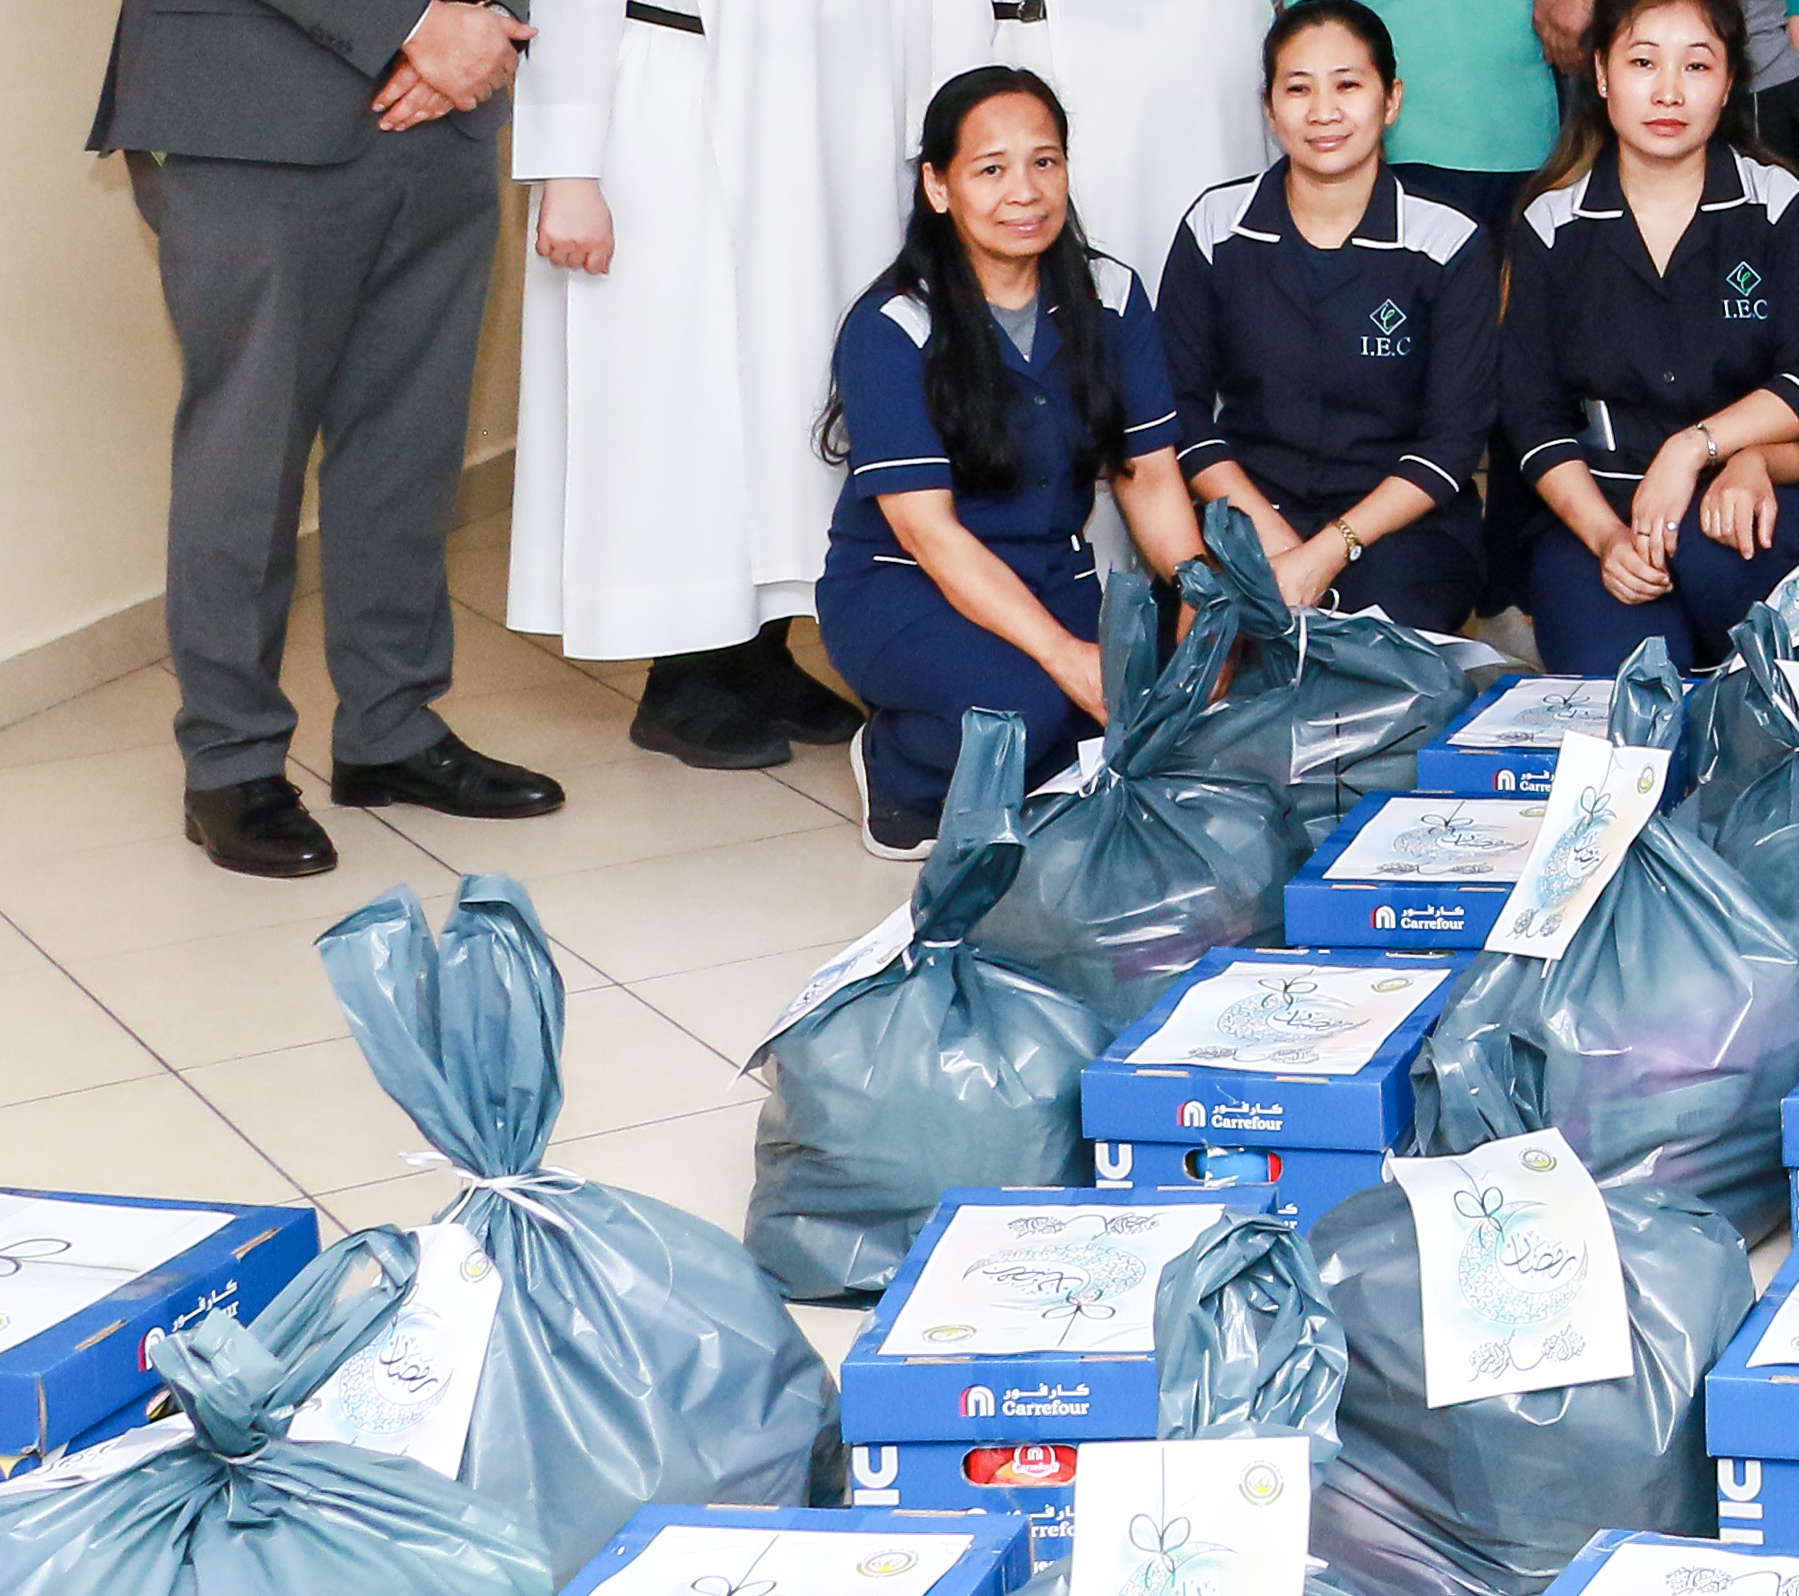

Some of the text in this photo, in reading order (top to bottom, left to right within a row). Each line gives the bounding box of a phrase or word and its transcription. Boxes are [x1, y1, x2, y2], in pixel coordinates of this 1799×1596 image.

[1520, 781, 1552, 792] Carre
[1402, 905, 1463, 918] كارفور
[1401, 917, 1463, 930] Carrefour
[1212, 1102, 1283, 1116] كارفور
[1211, 1115, 1282, 1131] Carrefour
[172, 1279, 238, 1331] كارفور
[1003, 1383, 1089, 1399] كارفور
[1002, 1401, 1090, 1417] Carrefour
